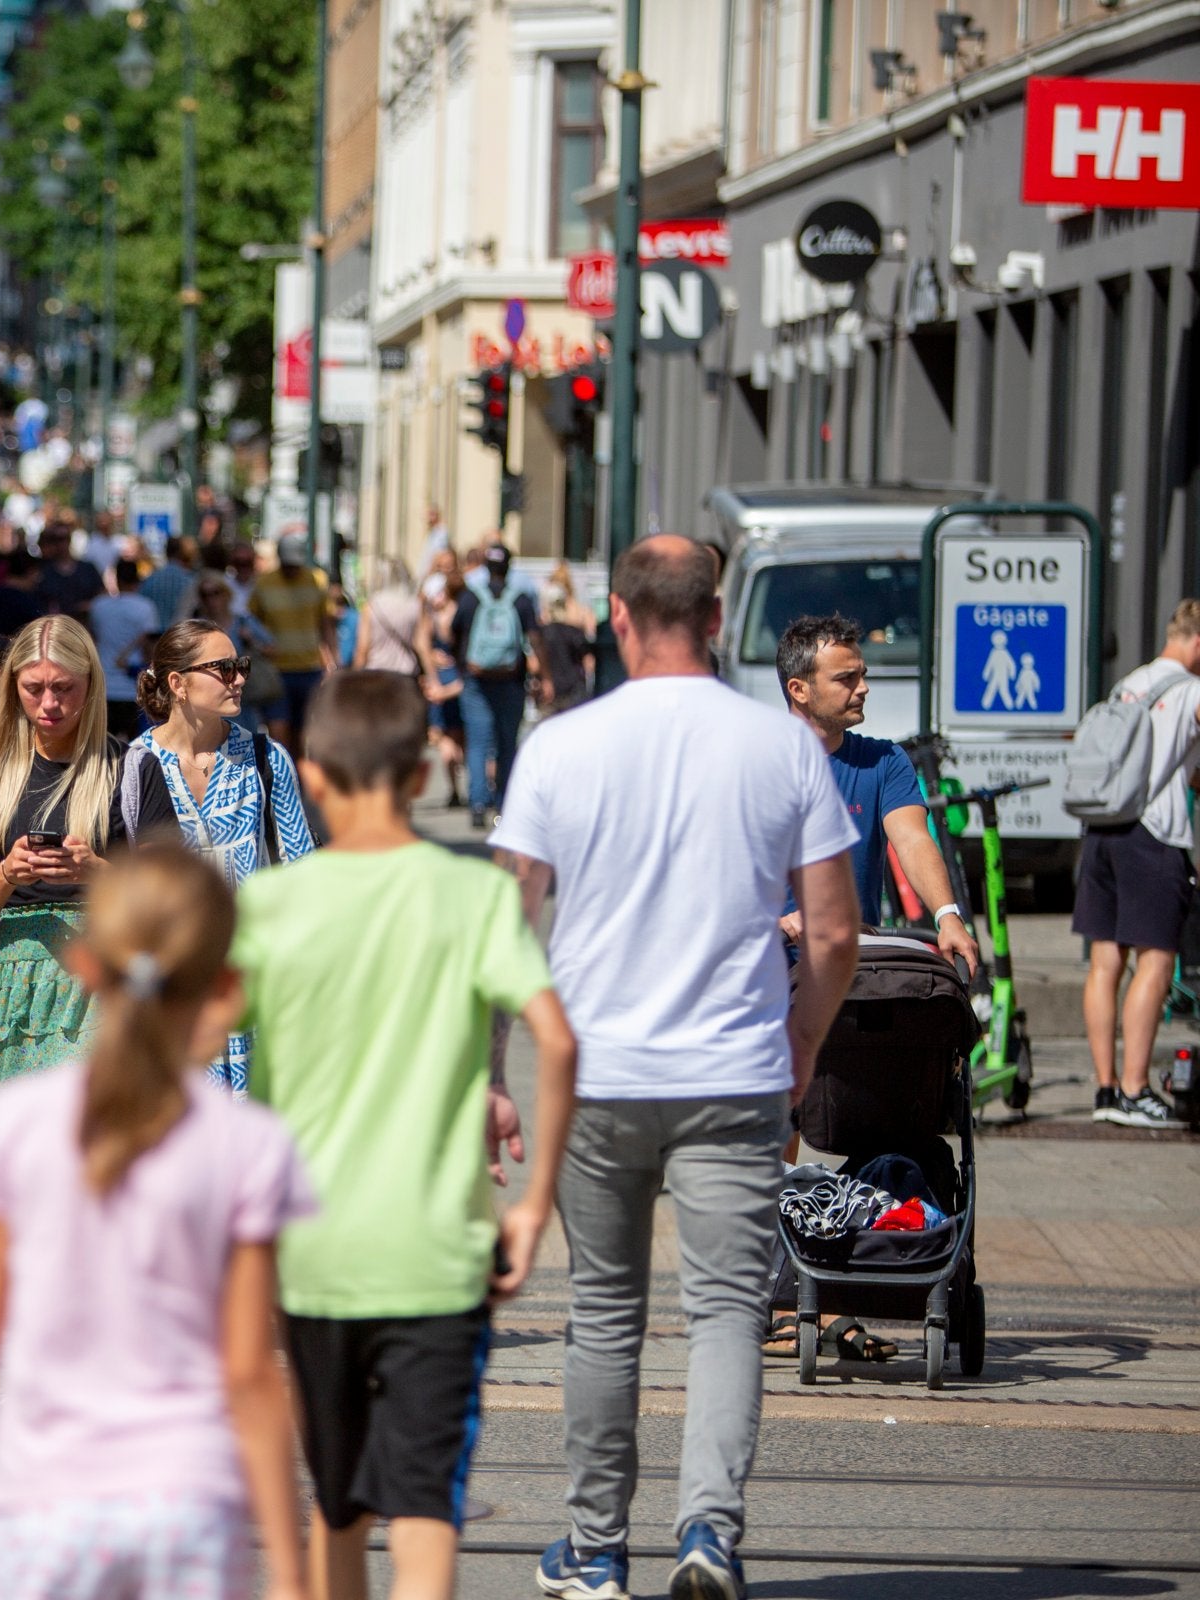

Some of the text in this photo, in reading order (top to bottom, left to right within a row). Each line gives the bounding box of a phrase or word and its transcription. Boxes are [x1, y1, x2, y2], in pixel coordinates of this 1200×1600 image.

[1052, 104, 1186, 181] HH
[966, 548, 1060, 583] Sone
[973, 604, 1050, 631] Gågate
